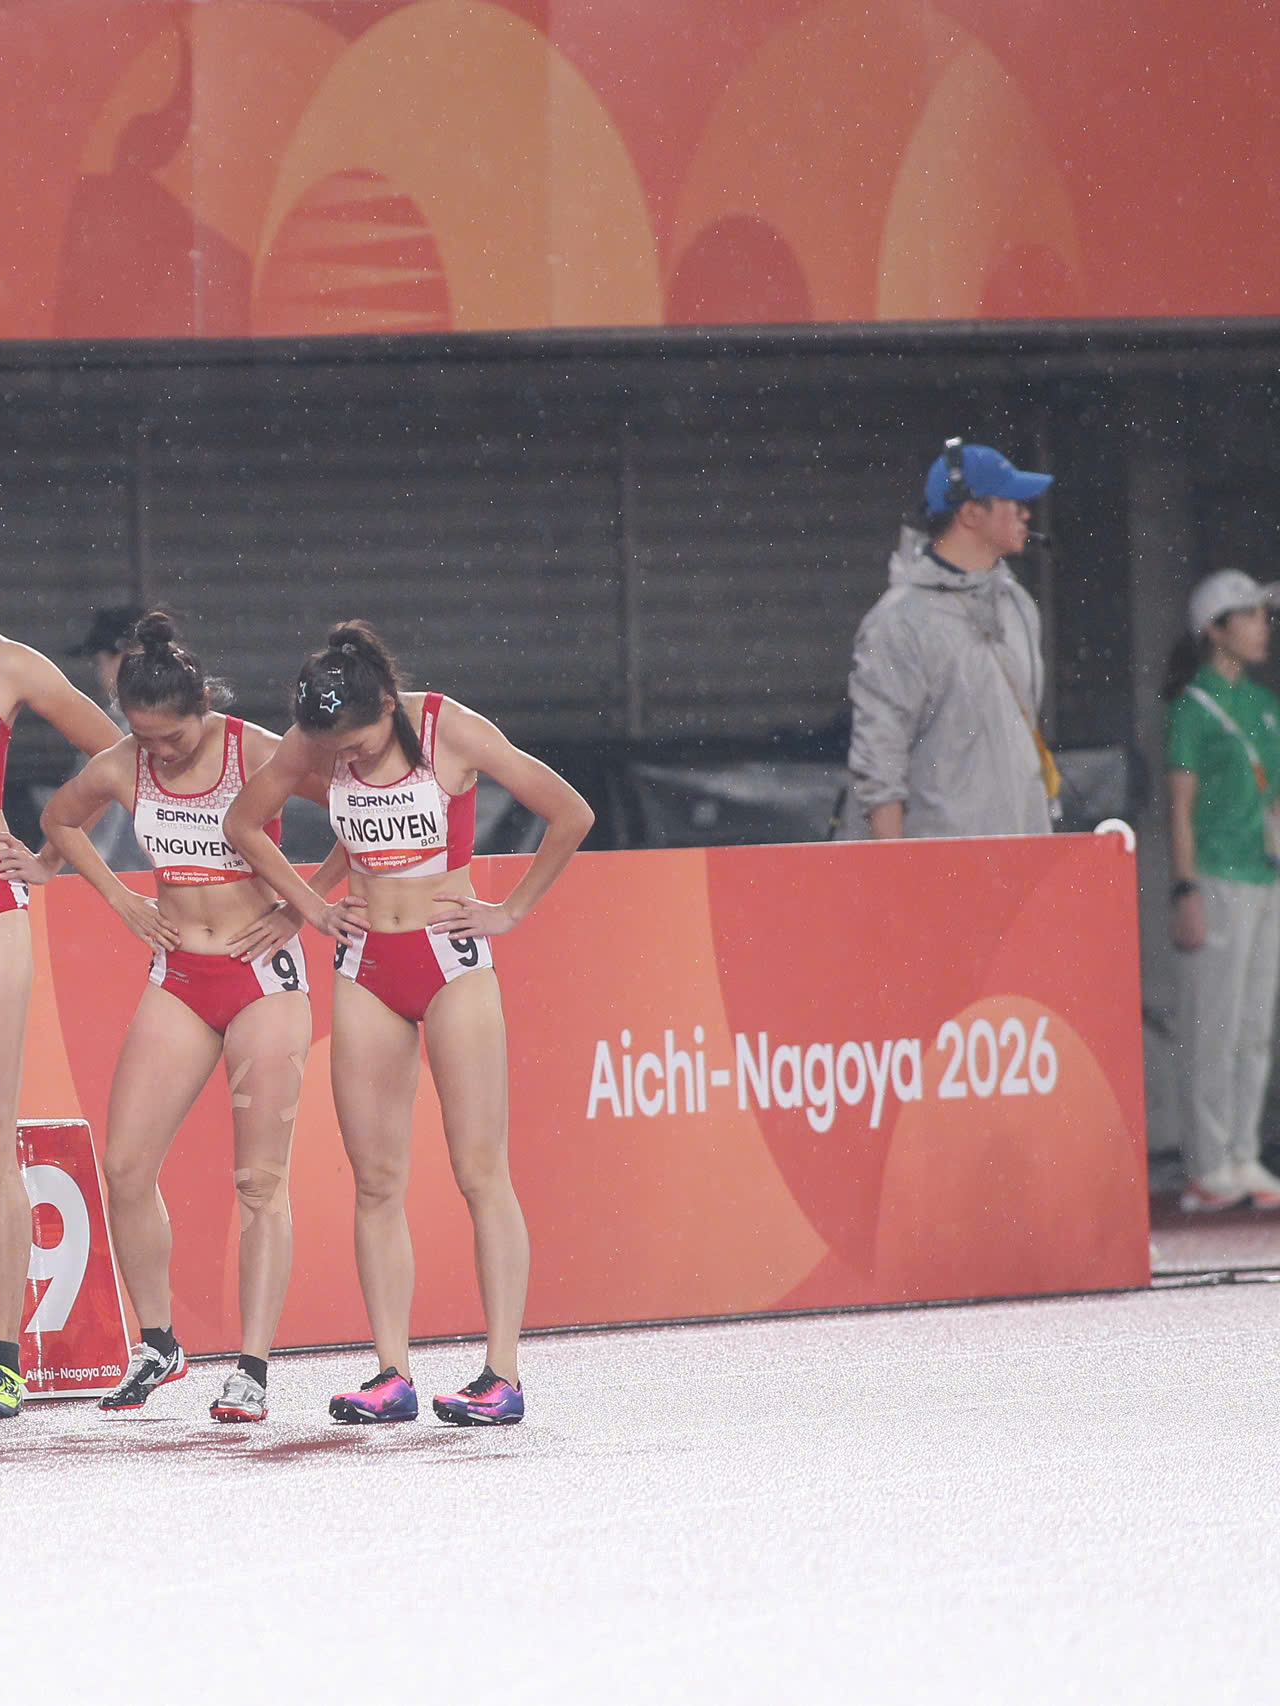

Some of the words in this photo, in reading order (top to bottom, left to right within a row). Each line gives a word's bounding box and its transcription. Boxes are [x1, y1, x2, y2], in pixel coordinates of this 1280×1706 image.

[347, 791, 415, 808] BORNAN
[155, 808, 219, 825] BORNAN
[336, 811, 437, 842] T.NGUYEN
[143, 834, 237, 857] T.NGUYEN
[420, 835, 440, 847] 801
[449, 930, 478, 967] 9
[272, 949, 299, 991] 9
[586, 1025, 922, 1133] Aichi-Nagoya
[936, 1017, 1058, 1099] 2026
[22, 1164, 90, 1334] 9
[25, 1367, 100, 1382] Aichi-Nagoya
[101, 1365, 122, 1377] 2026
